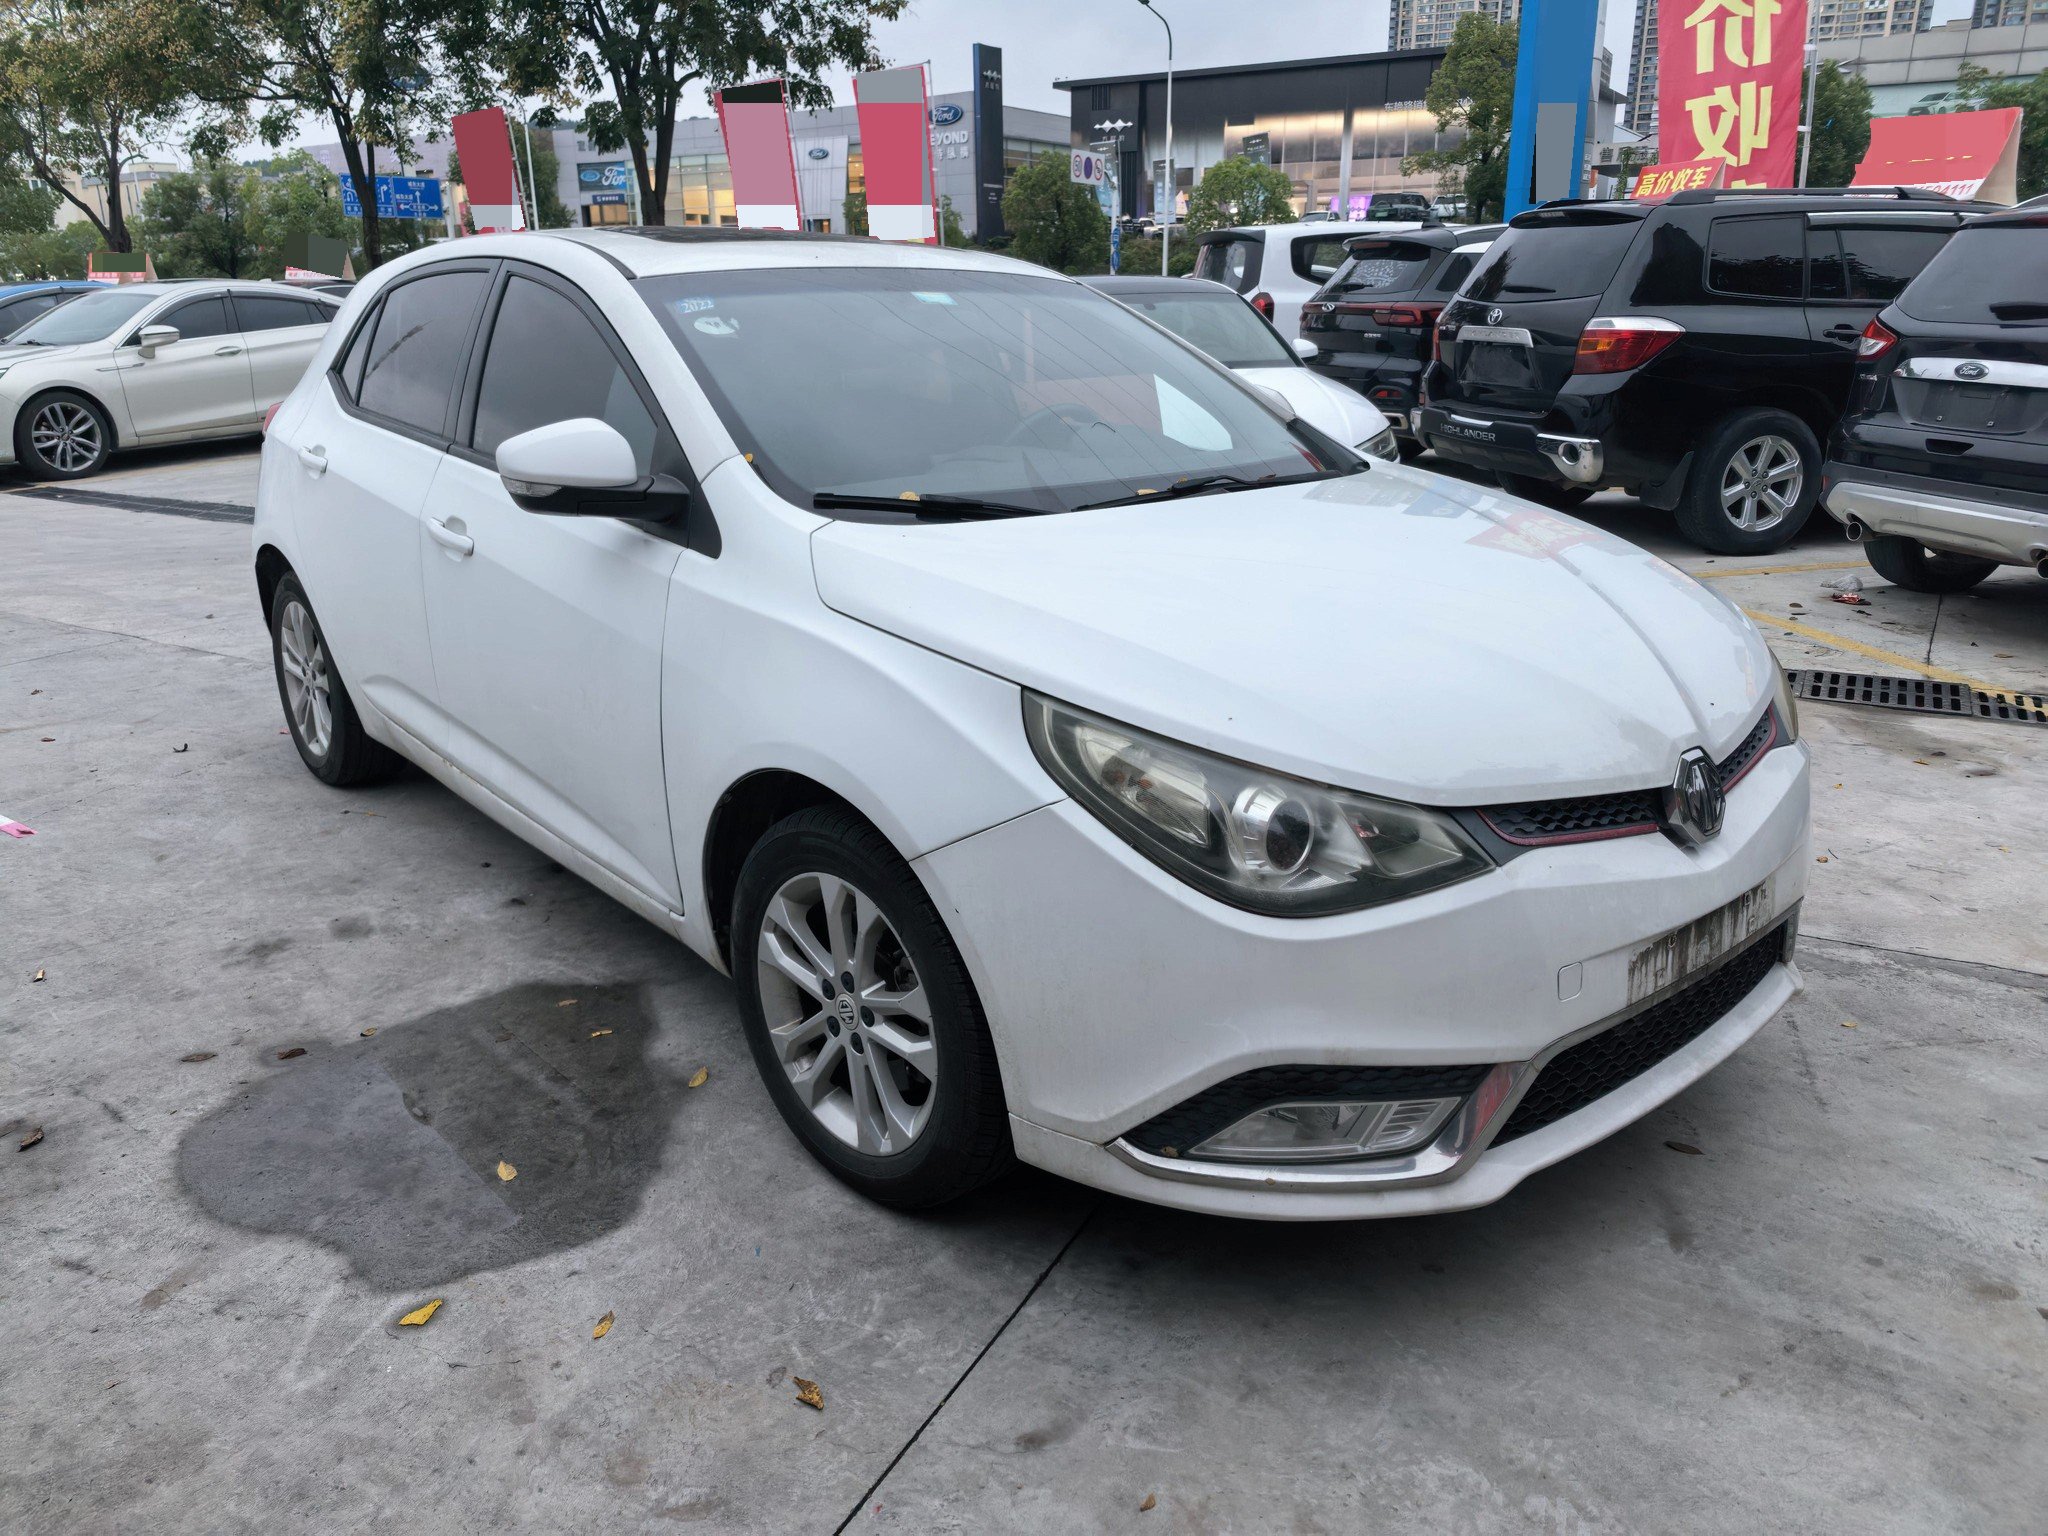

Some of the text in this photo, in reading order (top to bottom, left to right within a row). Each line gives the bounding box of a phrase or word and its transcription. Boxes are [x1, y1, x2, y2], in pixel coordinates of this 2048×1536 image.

[931, 130, 969, 146] EYOND
[602, 166, 626, 186] For
[1636, 166, 1712, 198] 高价收车
[1440, 423, 1496, 442] HIGHLANDER
